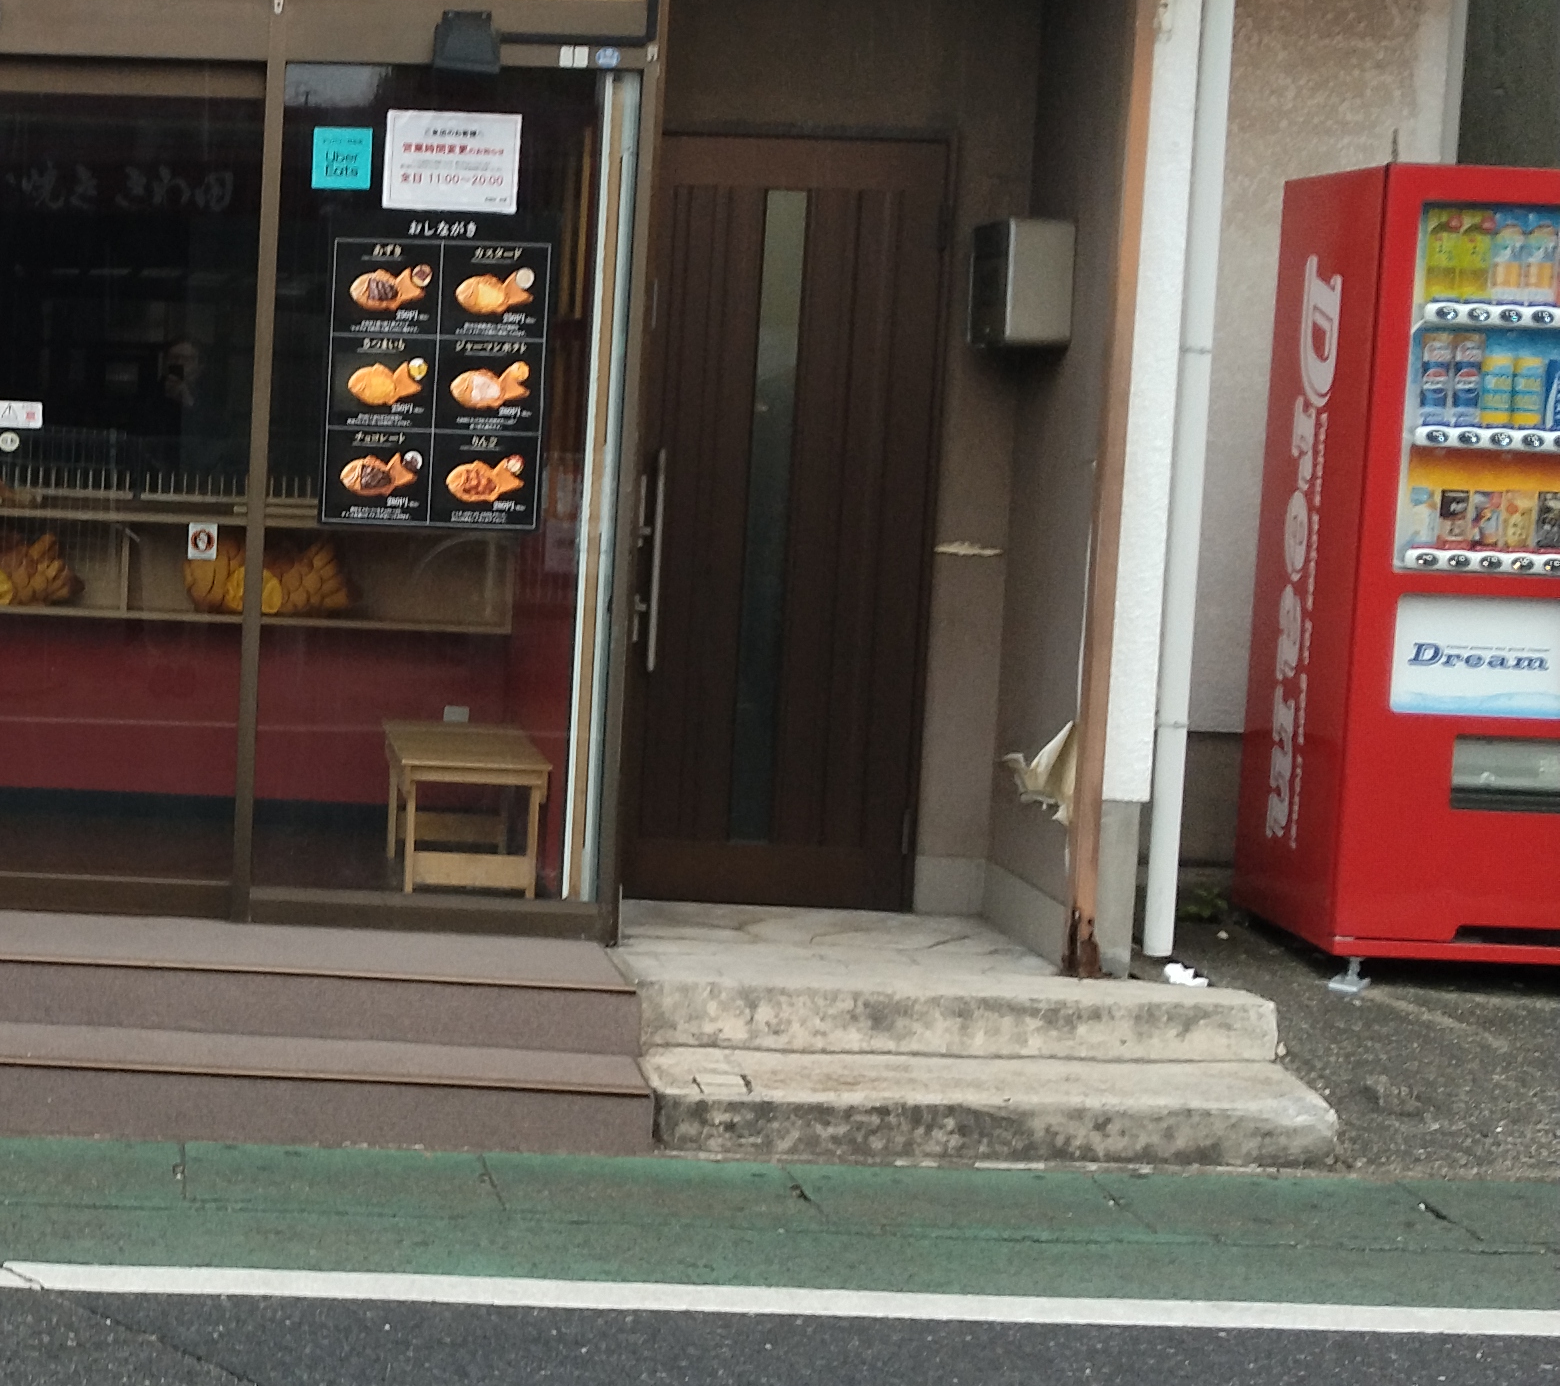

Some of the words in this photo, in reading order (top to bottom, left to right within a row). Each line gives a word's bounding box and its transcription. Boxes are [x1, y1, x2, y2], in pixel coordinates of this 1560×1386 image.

[407, 219, 477, 238] おしながき
[1263, 254, 1343, 839] Dream
[1407, 642, 1550, 671] Dream
